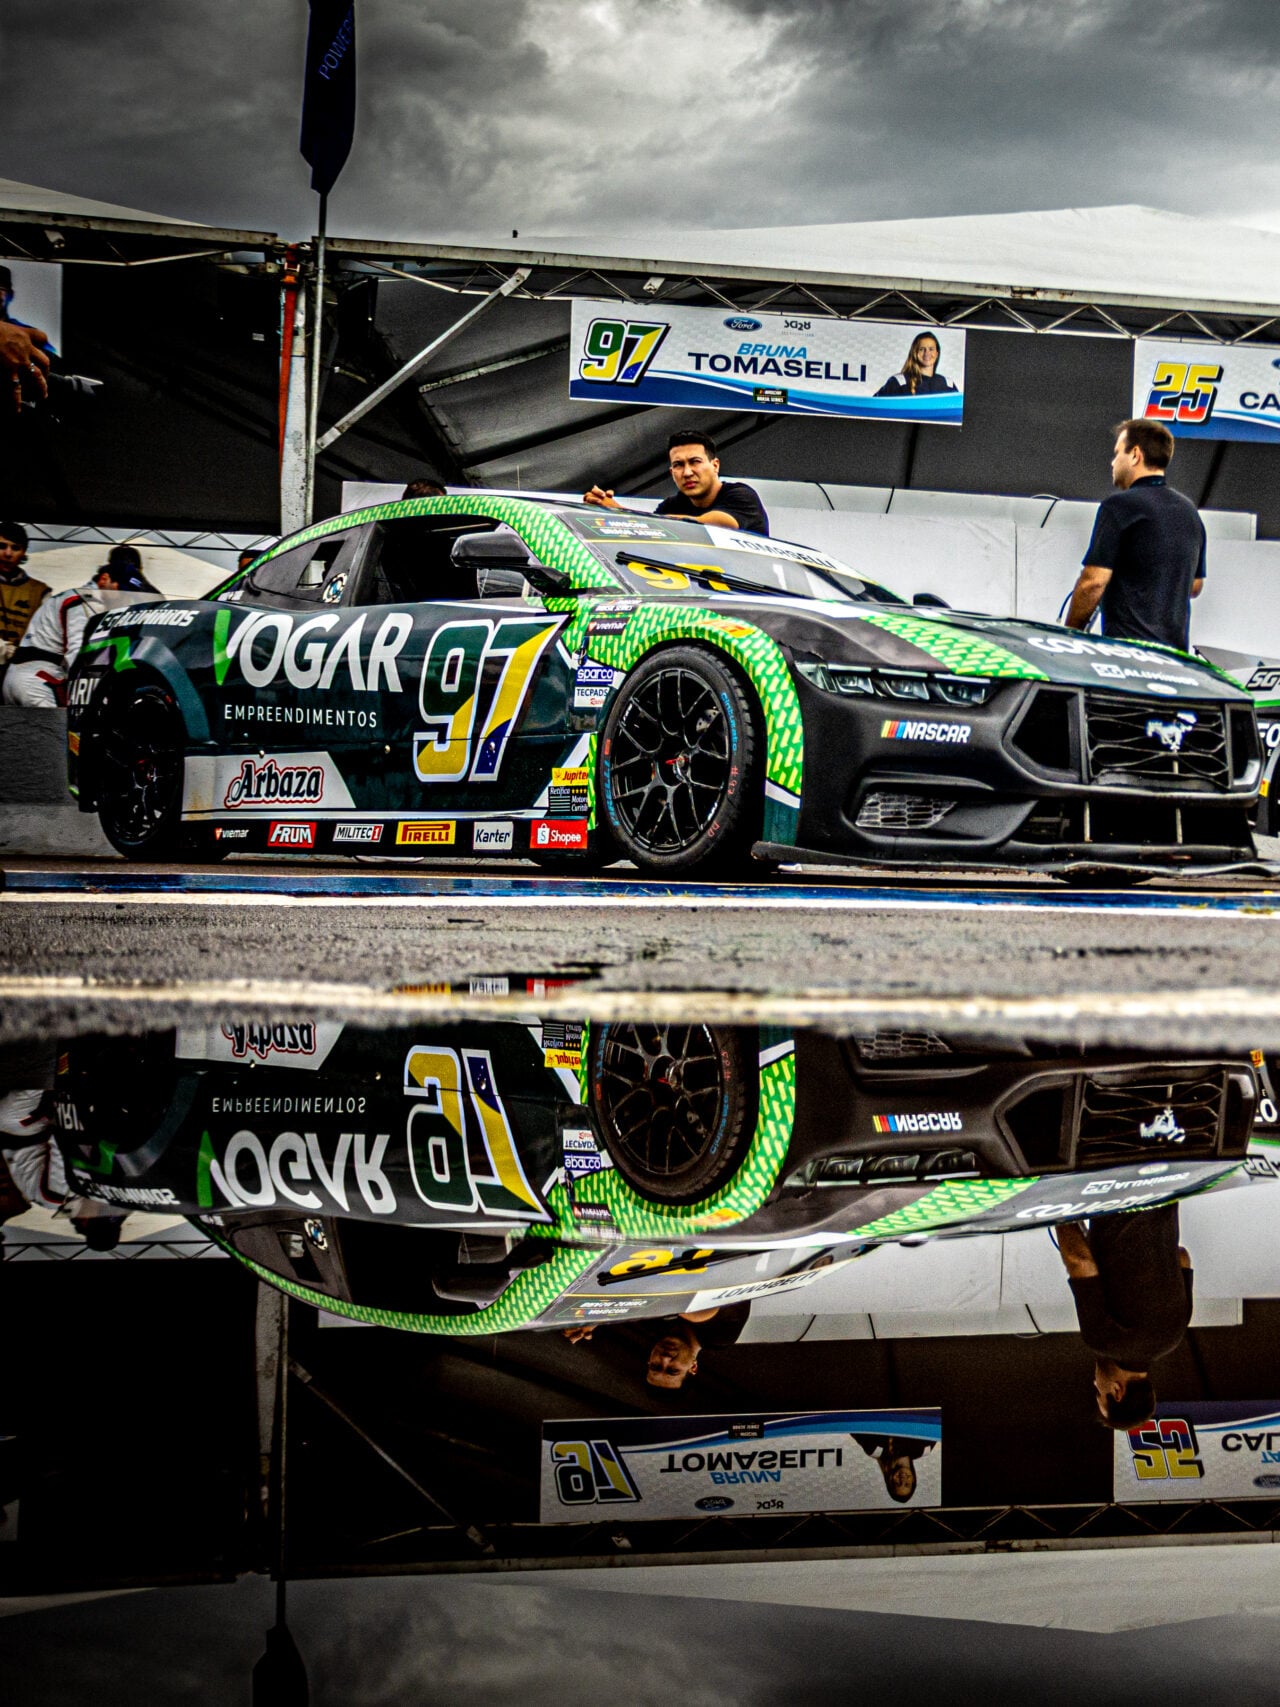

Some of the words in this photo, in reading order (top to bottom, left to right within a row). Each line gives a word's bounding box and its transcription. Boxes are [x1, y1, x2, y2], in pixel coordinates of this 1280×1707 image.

[579, 317, 670, 386] 97
[737, 342, 807, 359] BRUNA
[688, 352, 867, 383] TOMASELLI
[1143, 360, 1224, 425] 25
[212, 608, 415, 692] VOGAR
[576, 667, 614, 682] sparco
[412, 612, 569, 783] 97
[576, 688, 609, 697] TECPADS
[224, 703, 378, 728] EMPREENDIMENTOS
[902, 721, 972, 744] NASCAR
[226, 761, 323, 807] Arbaza
[221, 827, 249, 840] viemar
[269, 824, 313, 844] FRUM
[400, 824, 451, 843] PIRELLI
[474, 828, 511, 844] Karter
[550, 829, 582, 845] Shopee
